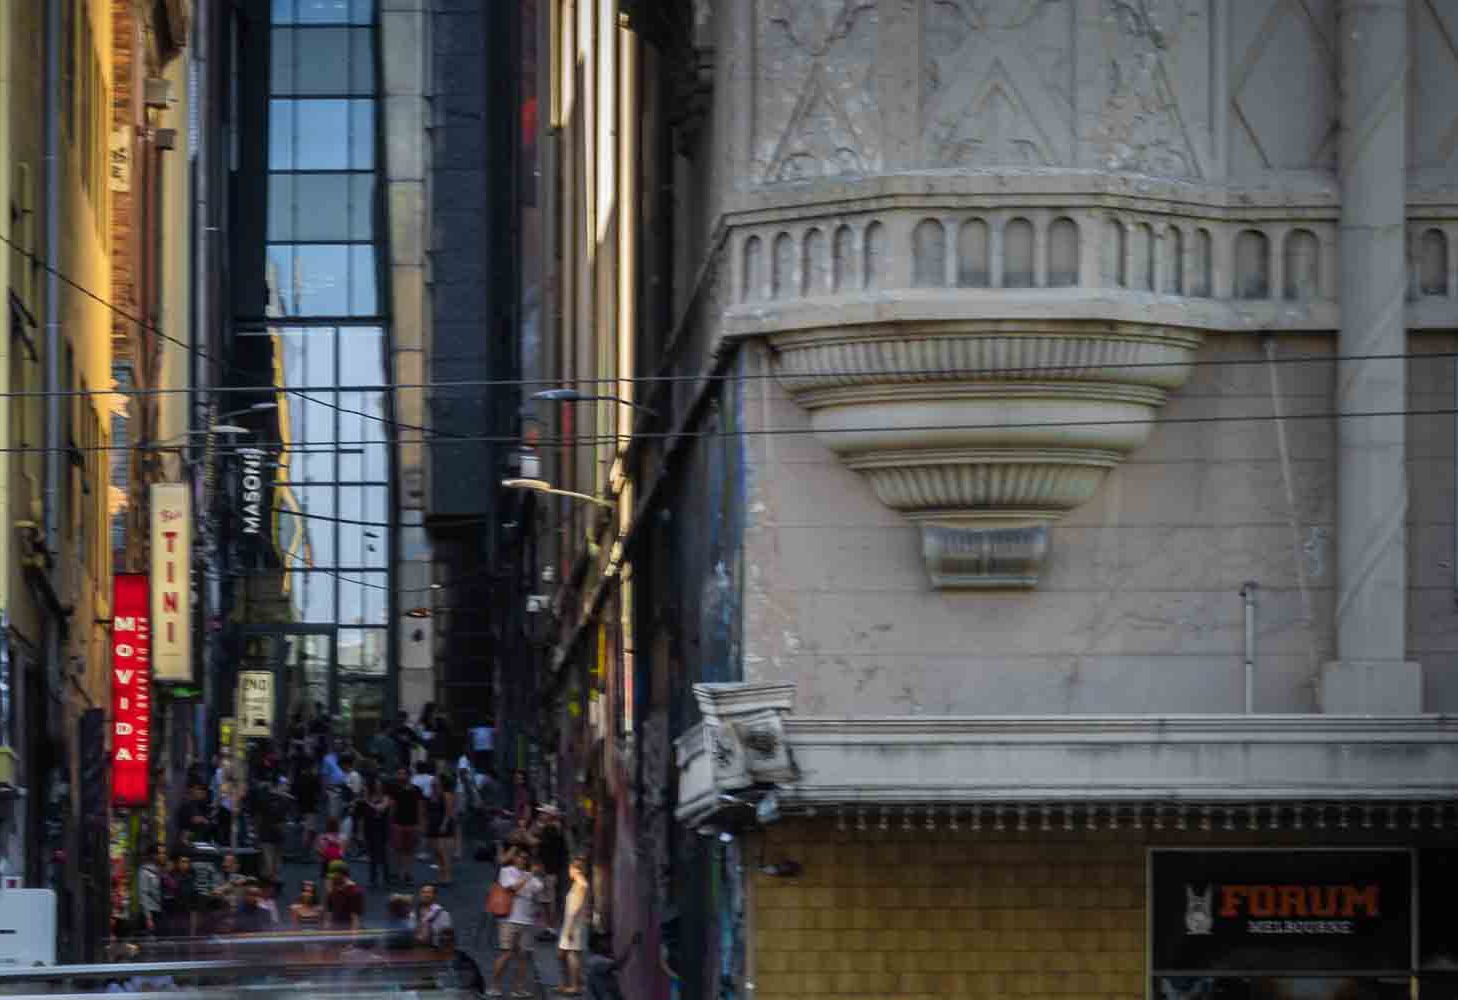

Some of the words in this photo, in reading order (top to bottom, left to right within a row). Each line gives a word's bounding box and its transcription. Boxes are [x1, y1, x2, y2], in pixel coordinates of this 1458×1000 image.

[161, 531, 179, 643] TINI
[114, 616, 136, 761] MOVIDA
[1218, 884, 1380, 917] FORUM
